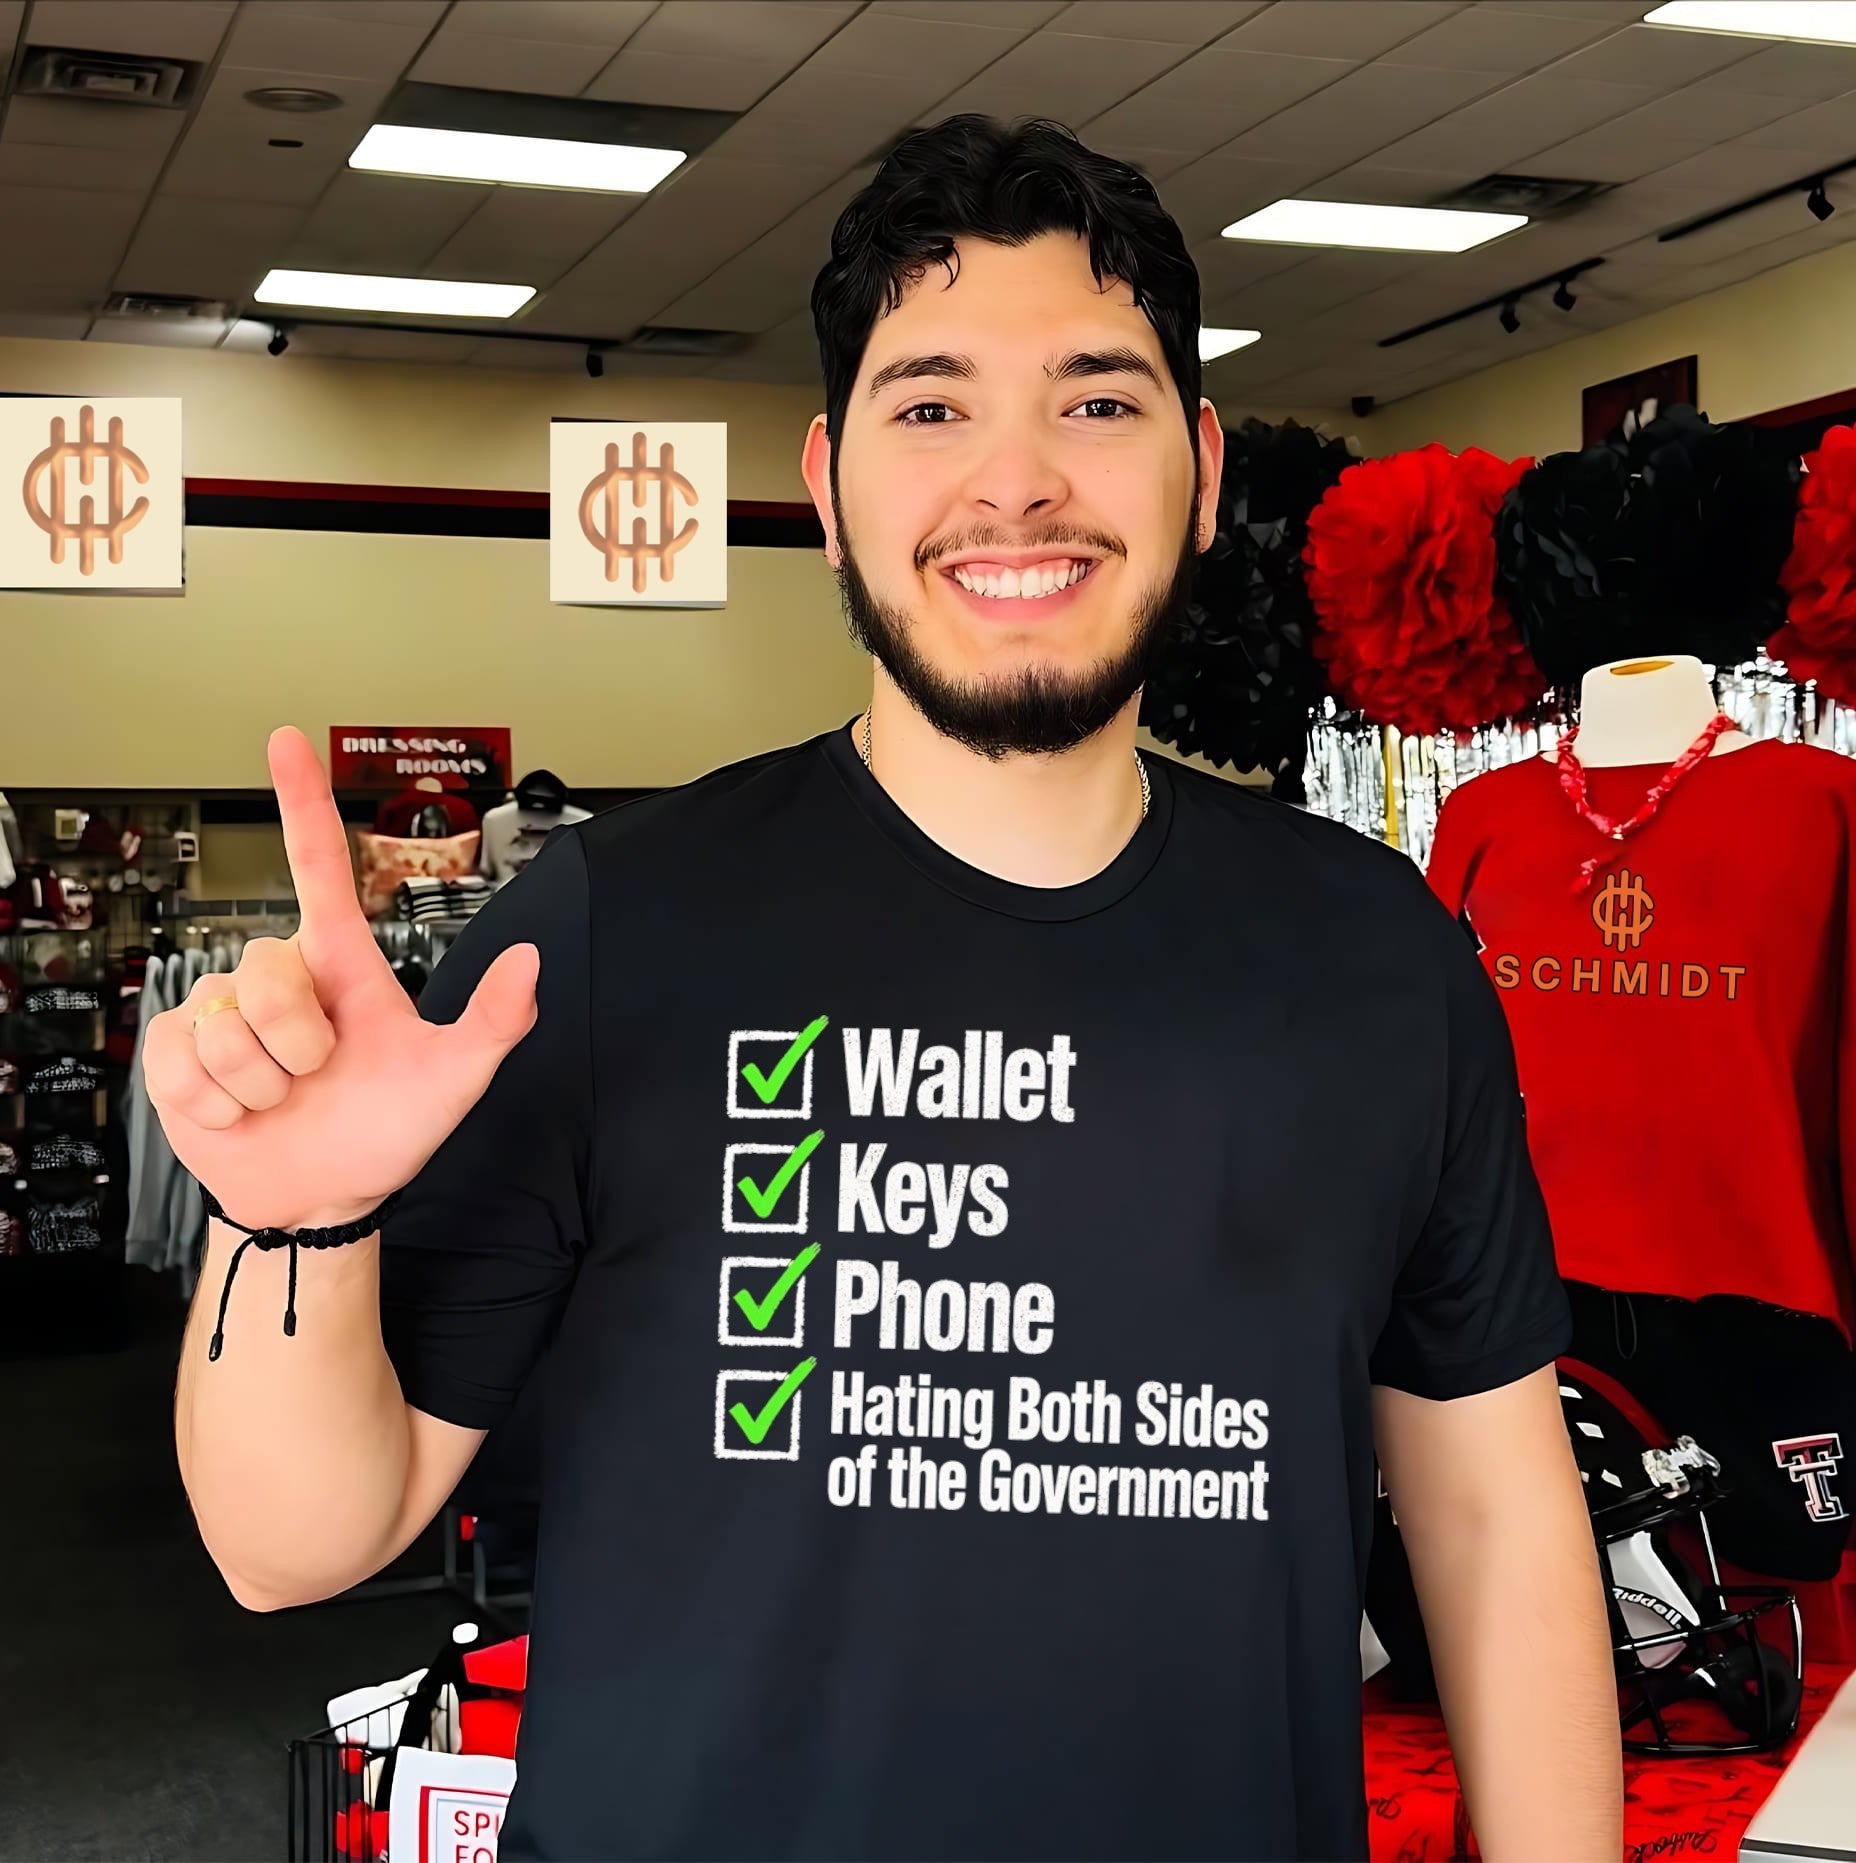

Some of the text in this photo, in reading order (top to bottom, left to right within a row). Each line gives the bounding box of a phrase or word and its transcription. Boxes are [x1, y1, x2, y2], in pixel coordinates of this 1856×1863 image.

[342, 737, 467, 753] DRESSING
[396, 758, 487, 774] ROOMS
[1494, 954, 1746, 1000] SCHMIDT
[842, 1027, 1077, 1123] Wallet
[837, 1142, 1010, 1249] Keys
[833, 1259, 1056, 1355] Phone
[829, 1370, 1270, 1450] Hating Both Sides
[827, 1443, 1270, 1521] of the Government
